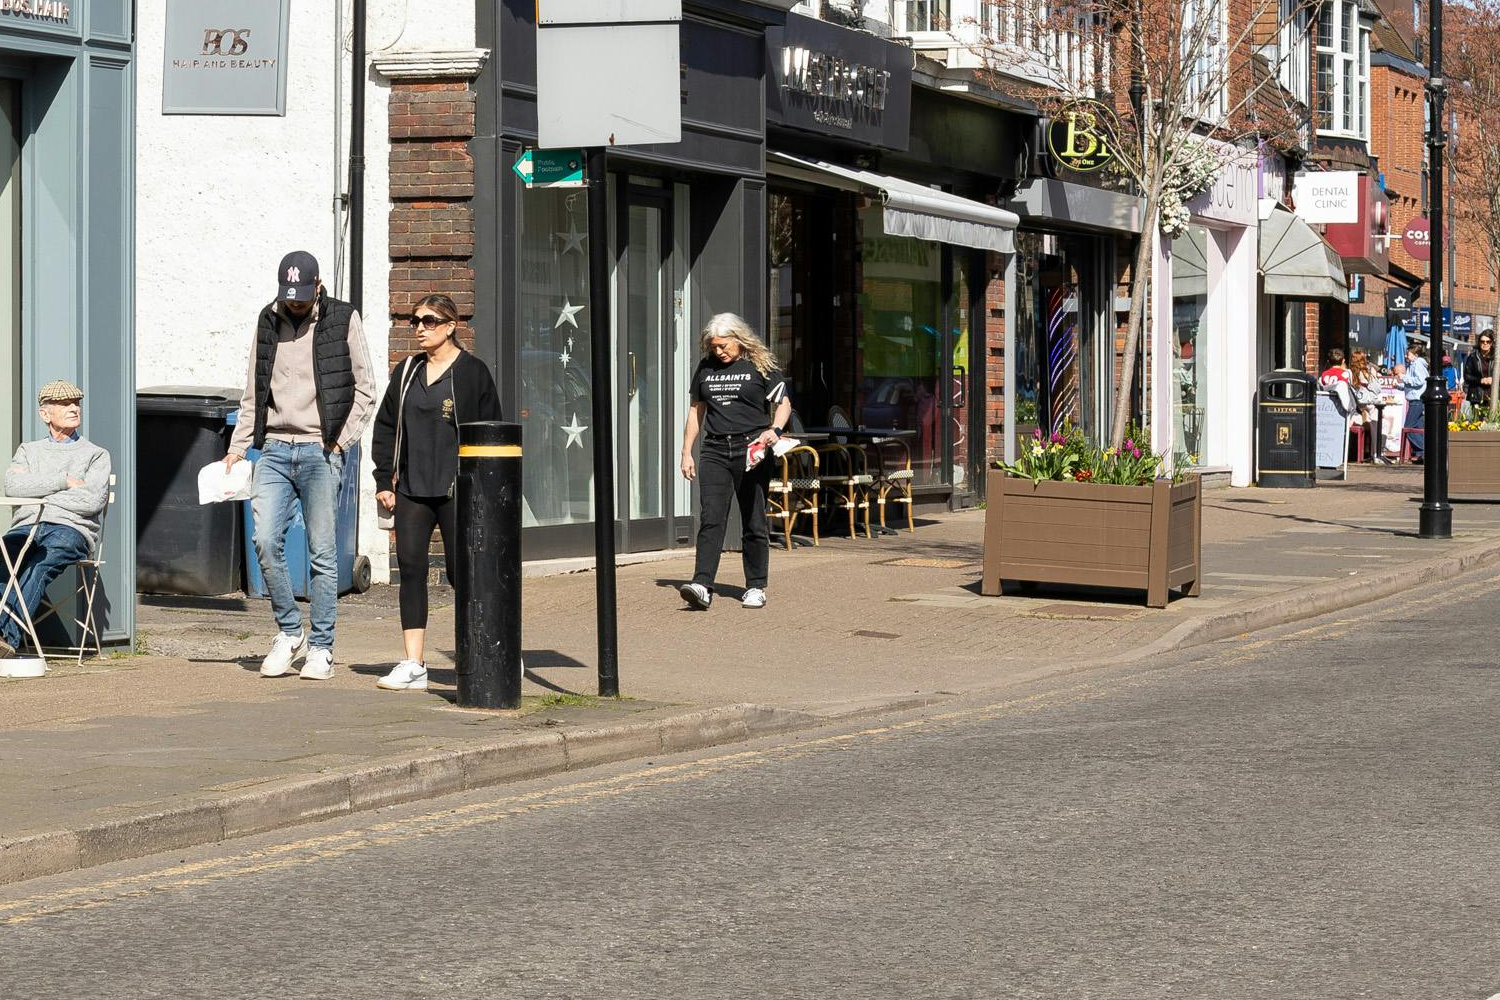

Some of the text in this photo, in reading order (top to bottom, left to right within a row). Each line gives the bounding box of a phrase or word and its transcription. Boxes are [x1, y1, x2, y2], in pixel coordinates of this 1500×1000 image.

[200, 28, 251, 56] BOS
[172, 60, 276, 69] HAIR AND BEAUTY
[1312, 187, 1349, 197] DENTAL
[1315, 200, 1348, 208] CLINIC
[1406, 230, 1430, 241] COS
[705, 374, 752, 382] ALLSAINTS
